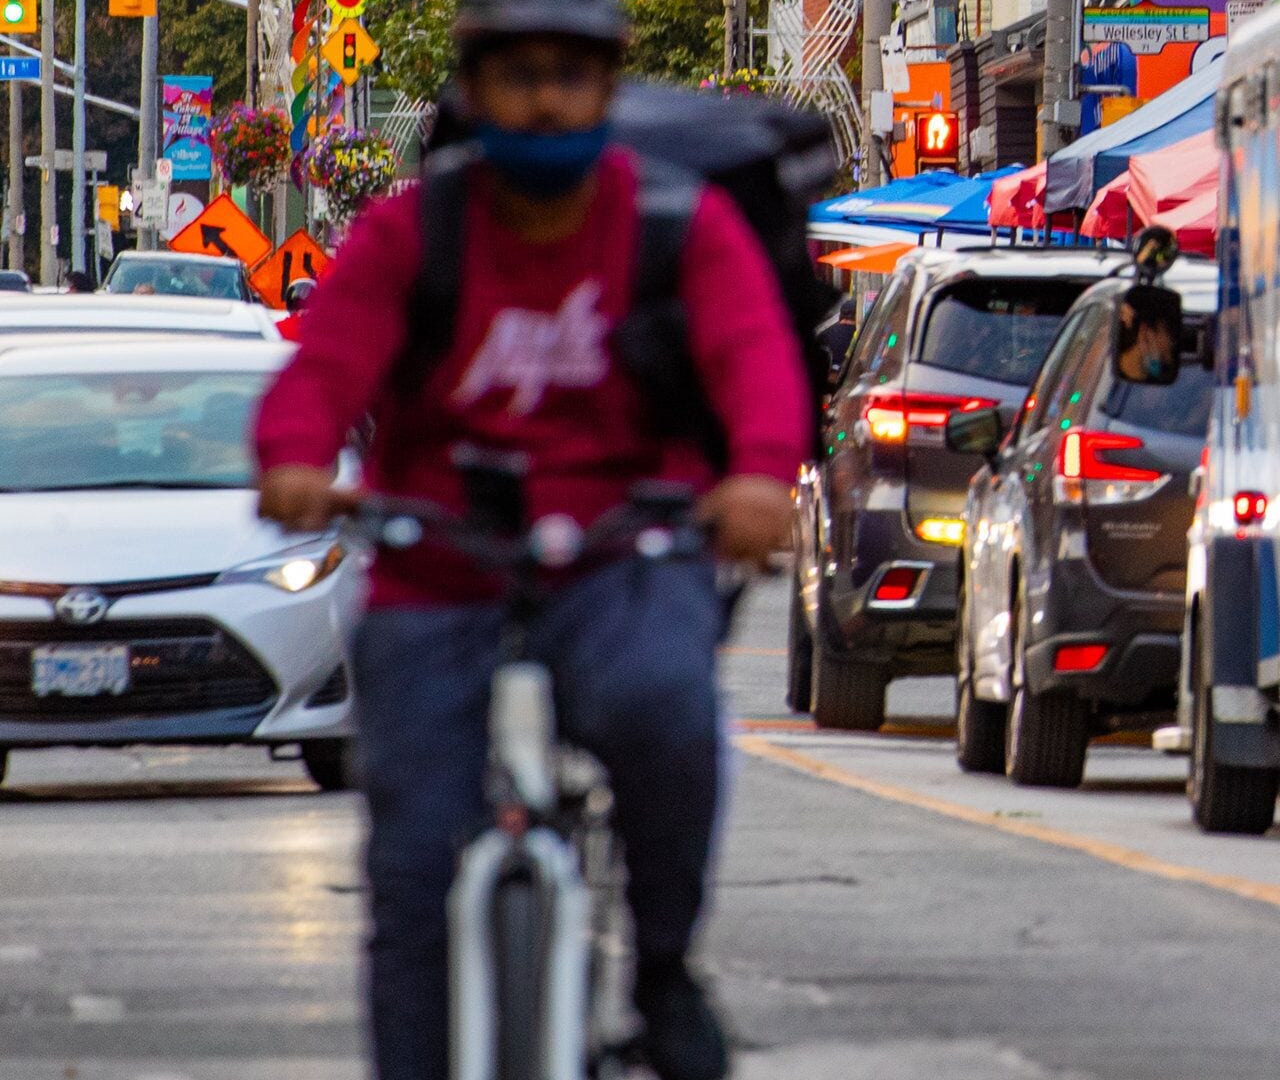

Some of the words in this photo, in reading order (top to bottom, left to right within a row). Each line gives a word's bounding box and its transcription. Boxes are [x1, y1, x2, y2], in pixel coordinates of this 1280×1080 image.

[1103, 25, 1162, 42] Wellesley
[1166, 25, 1178, 40] St
[1182, 26, 1189, 40] E
